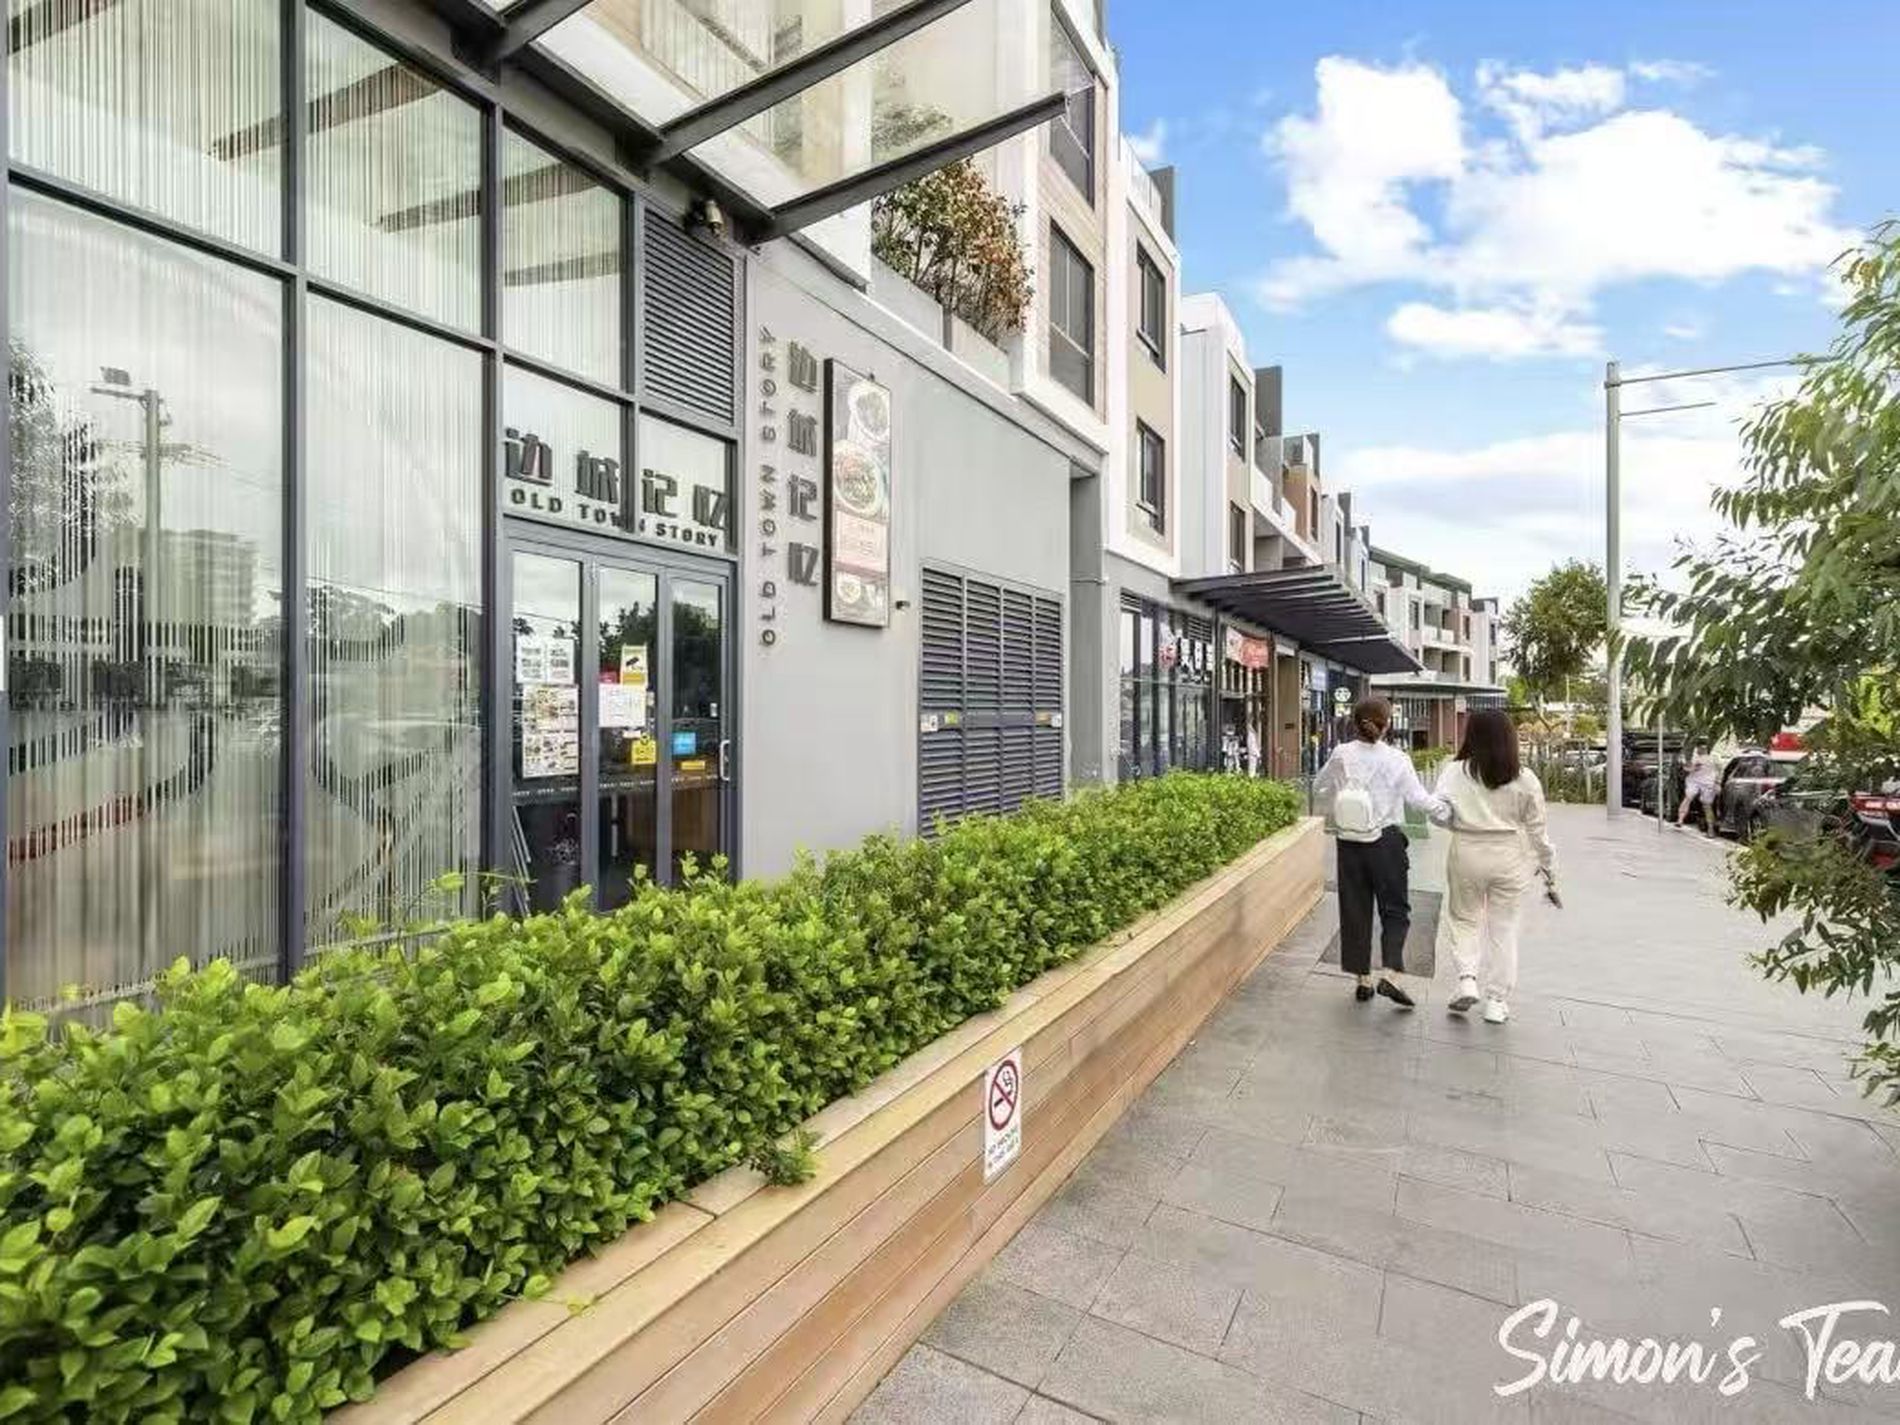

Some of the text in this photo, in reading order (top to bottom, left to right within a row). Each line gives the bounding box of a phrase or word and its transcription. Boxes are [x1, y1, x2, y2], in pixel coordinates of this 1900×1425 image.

[511, 487, 563, 513] OLD
[656, 522, 718, 547] STORY
[760, 326, 776, 646] OLD TOWN STORY
